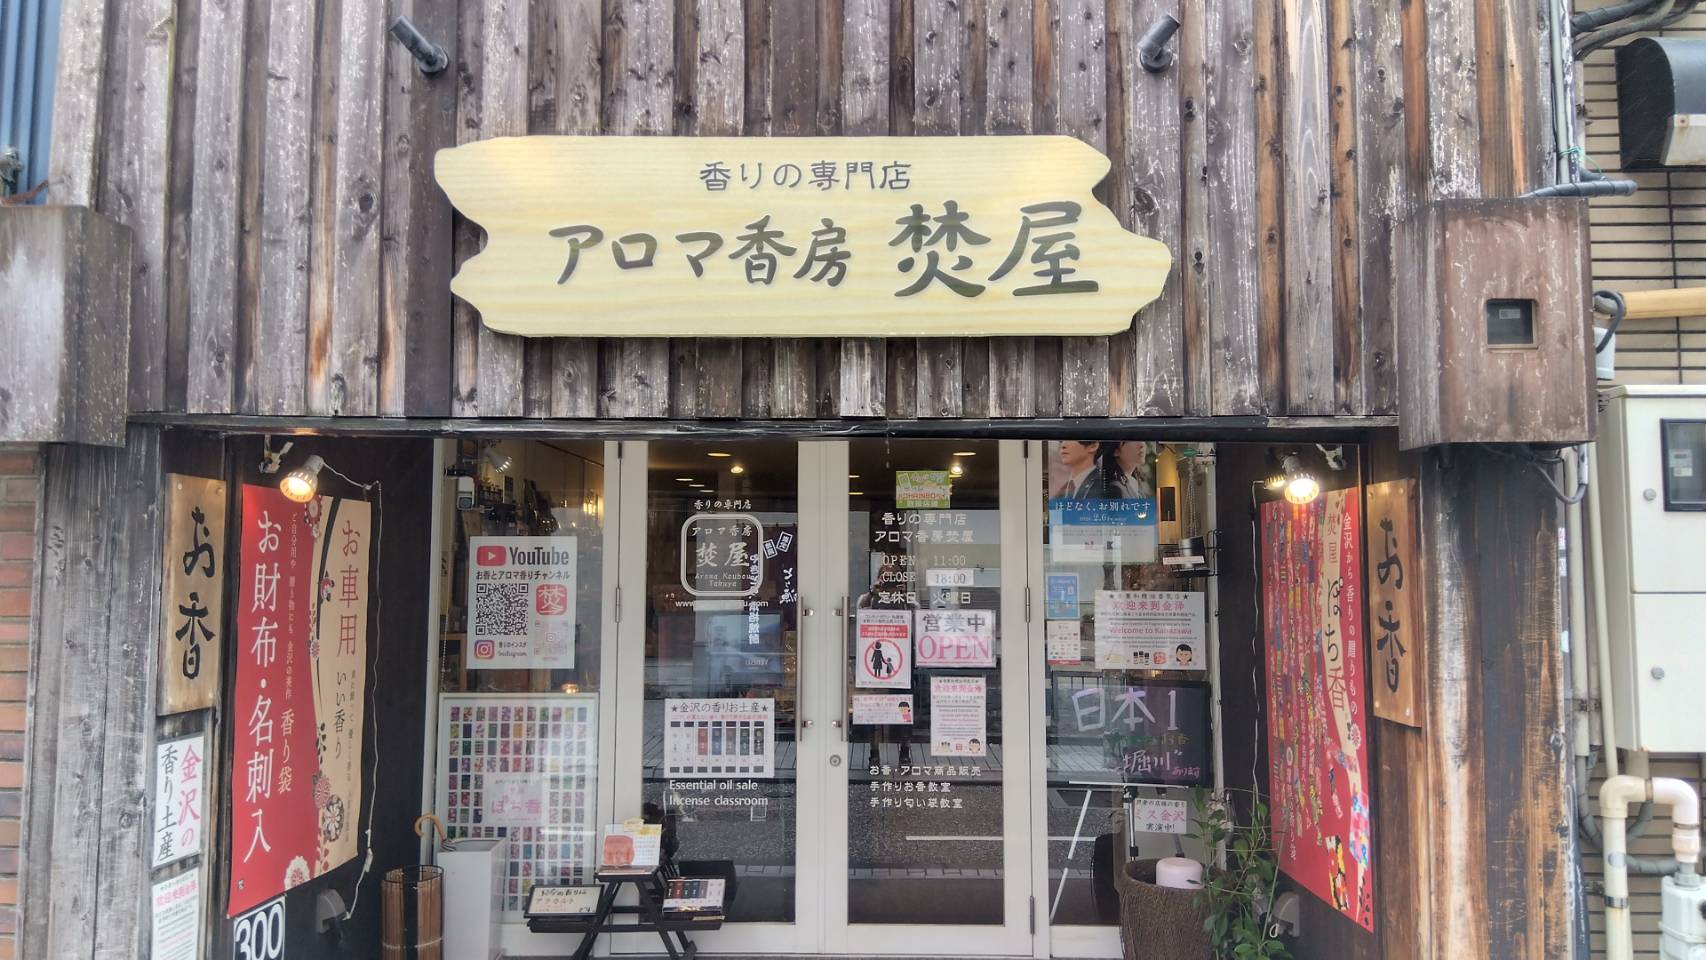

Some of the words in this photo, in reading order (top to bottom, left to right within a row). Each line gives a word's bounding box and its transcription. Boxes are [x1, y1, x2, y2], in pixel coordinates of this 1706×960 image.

[699, 159, 913, 192] 香りの専門店
[547, 214, 853, 288] アロマ香房
[887, 198, 1101, 299] 焚屋
[693, 499, 752, 510] 香りの専門店
[1055, 501, 1151, 512] ほどなく、お別れです
[881, 512, 967, 526] 香りの専門店
[691, 524, 753, 537] アロマ香房
[509, 546, 570, 566] YouTube
[695, 541, 750, 568] 焚屋
[882, 555, 916, 566] OPEN
[933, 555, 966, 566] 11:00
[476, 571, 571, 581] お香とアロマ香りチャンネル
[882, 571, 916, 582] CLOSE
[935, 573, 966, 584] 18:00
[336, 519, 361, 658] お車用
[878, 591, 917, 604] 定休日
[922, 613, 986, 633] 営業中
[1110, 627, 1144, 635] Welcome
[1154, 627, 1192, 635] Kanazawa
[918, 635, 992, 661] OPEN
[680, 702, 760, 713] 金沢の香りお土産
[277, 708, 295, 795] 香り袋
[869, 765, 982, 777] お香・アロマ商品販売
[669, 779, 716, 790] Essential
[719, 779, 733, 790] oil
[736, 779, 758, 790] sale
[869, 781, 951, 793] 手作りお香教室
[177, 743, 202, 848] 金沢の
[669, 795, 711, 806] Incense
[714, 795, 769, 806] classroom
[157, 743, 179, 862] 香り土産
[869, 797, 963, 809] 手作り匂い袋教室
[1135, 808, 1186, 822] ミス金沢
[235, 903, 284, 960] 300
